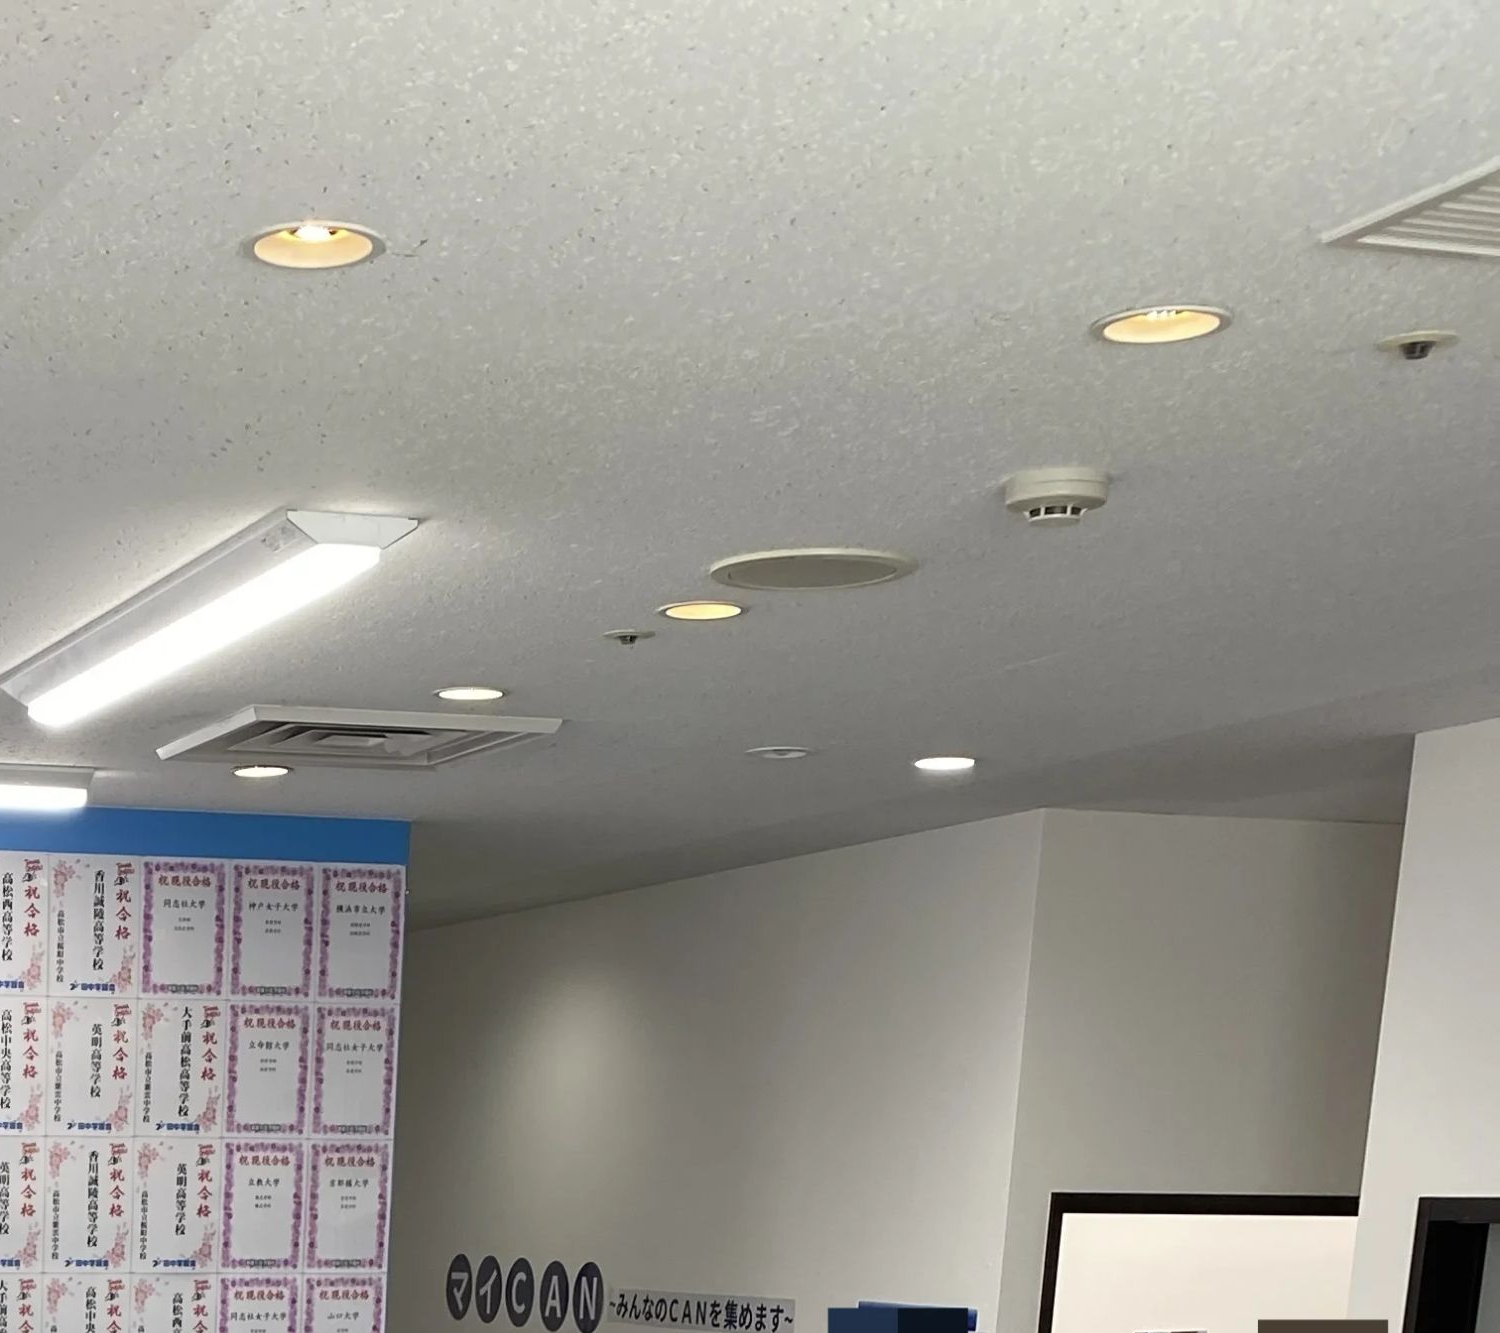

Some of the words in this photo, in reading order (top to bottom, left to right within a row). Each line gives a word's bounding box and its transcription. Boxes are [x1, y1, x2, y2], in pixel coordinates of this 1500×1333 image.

[2, 872, 13, 960] 高松西高等学校
[25, 886, 40, 936] 祝合格
[115, 885, 131, 939] 祝合格
[1, 1010, 12, 1109] 高松中央高等学校
[23, 1029, 38, 1078] 祝合格
[91, 1024, 102, 1097] 英明高等学校
[113, 1030, 128, 1079] 祝合格
[179, 1007, 191, 1116] 大手前高松高等学校
[201, 1032, 217, 1080] 祝合格
[0, 1162, 9, 1234] 英明高等学校
[21, 1168, 36, 1216] 祝合格
[110, 1169, 124, 1217] 祝合格
[176, 1164, 187, 1235] 英明高等学校
[197, 1170, 212, 1217] 祝合格
[450, 1270, 599, 1322] マイCAN
